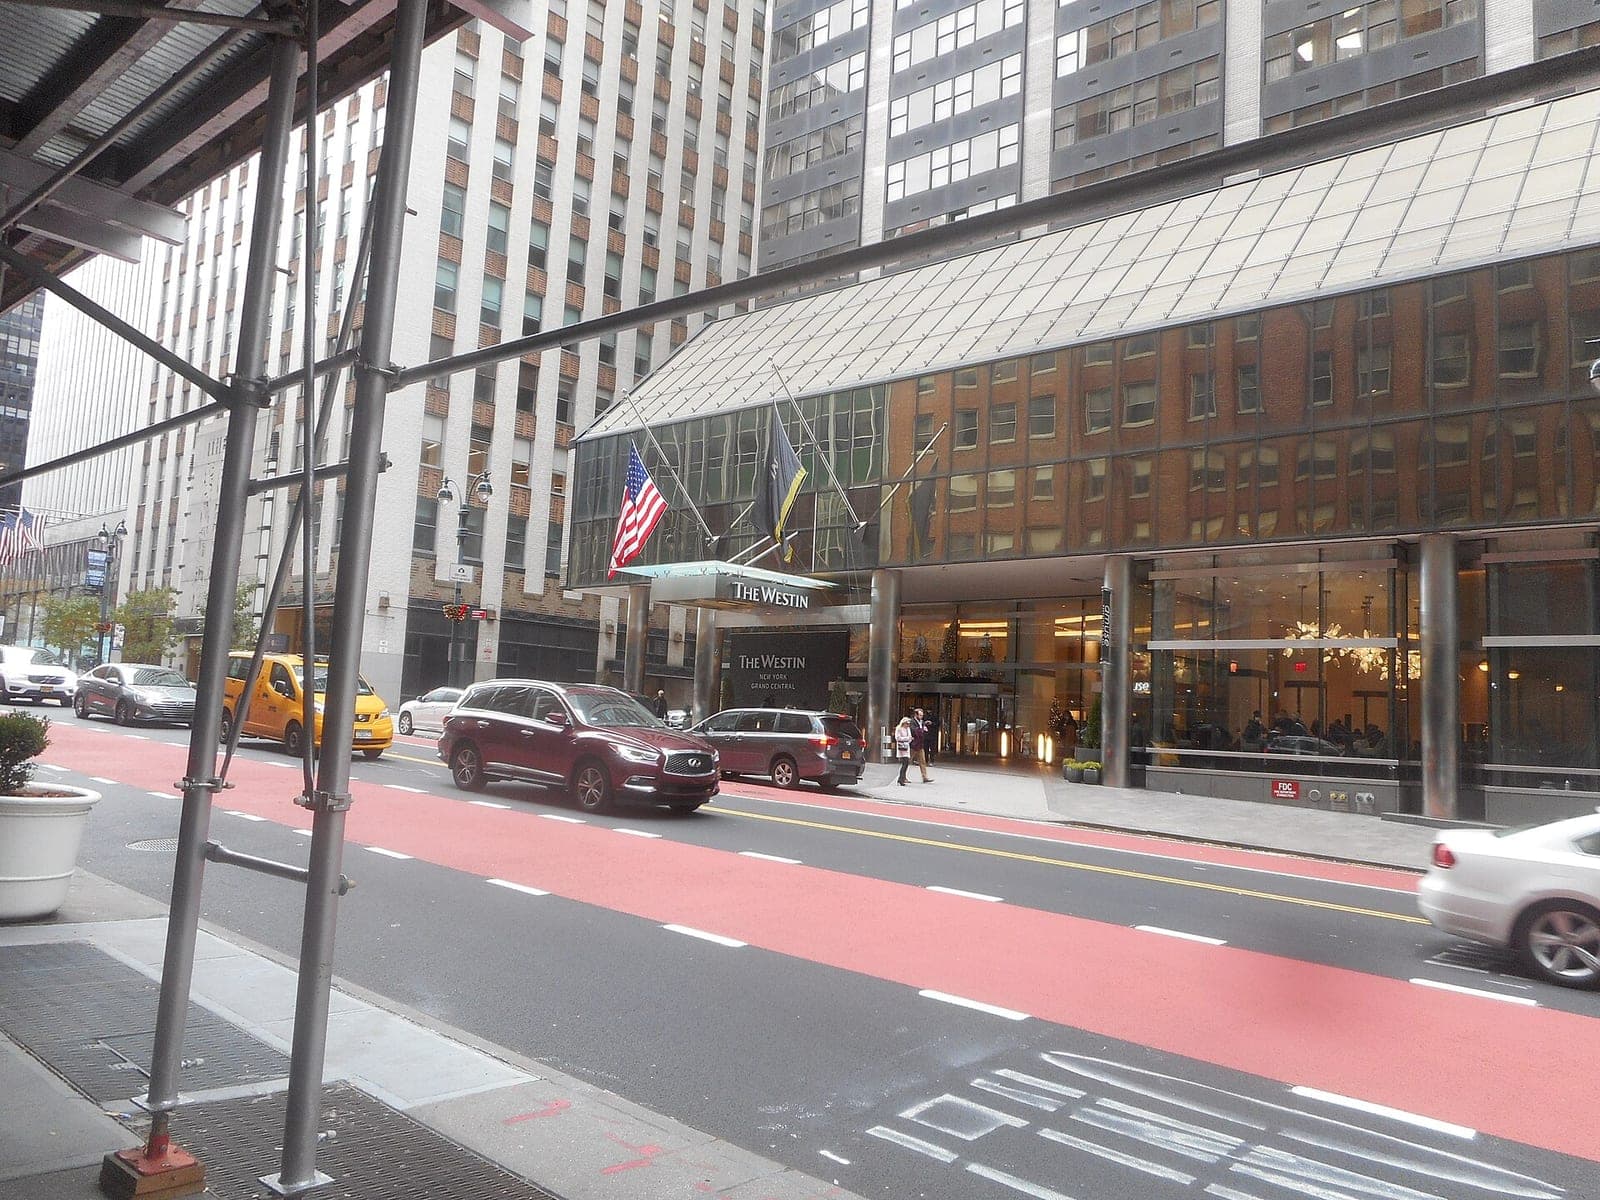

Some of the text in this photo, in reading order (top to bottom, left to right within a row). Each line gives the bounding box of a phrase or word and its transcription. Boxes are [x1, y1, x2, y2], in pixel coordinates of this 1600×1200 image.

[761, 586, 808, 609] WESTIN
[1102, 605, 1110, 647] amuse
[760, 654, 806, 669] WESTIN
[1278, 782, 1292, 791] FDC
